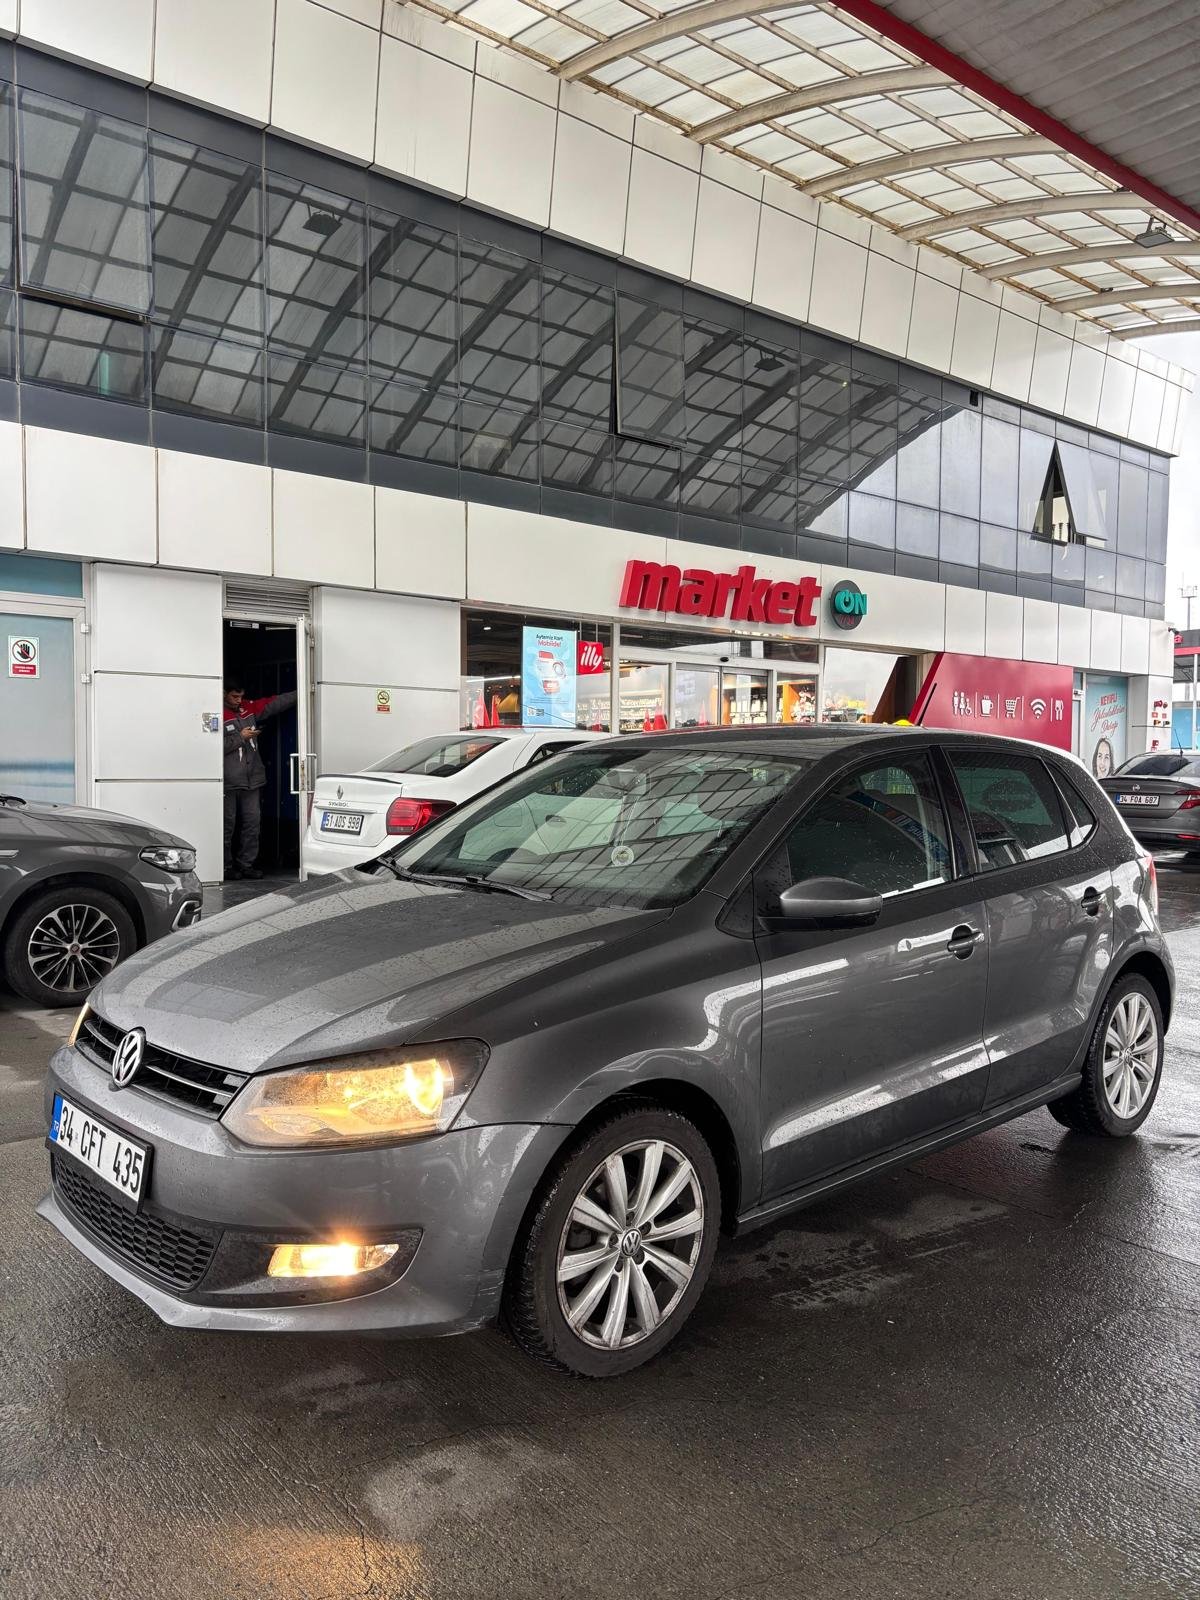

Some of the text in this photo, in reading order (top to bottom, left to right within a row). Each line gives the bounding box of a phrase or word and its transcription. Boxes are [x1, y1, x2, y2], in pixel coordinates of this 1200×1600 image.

[619, 560, 822, 627] market
[835, 590, 867, 615] ON
[581, 646, 602, 671] illy
[60, 1106, 143, 1193] 34 CFT 435
